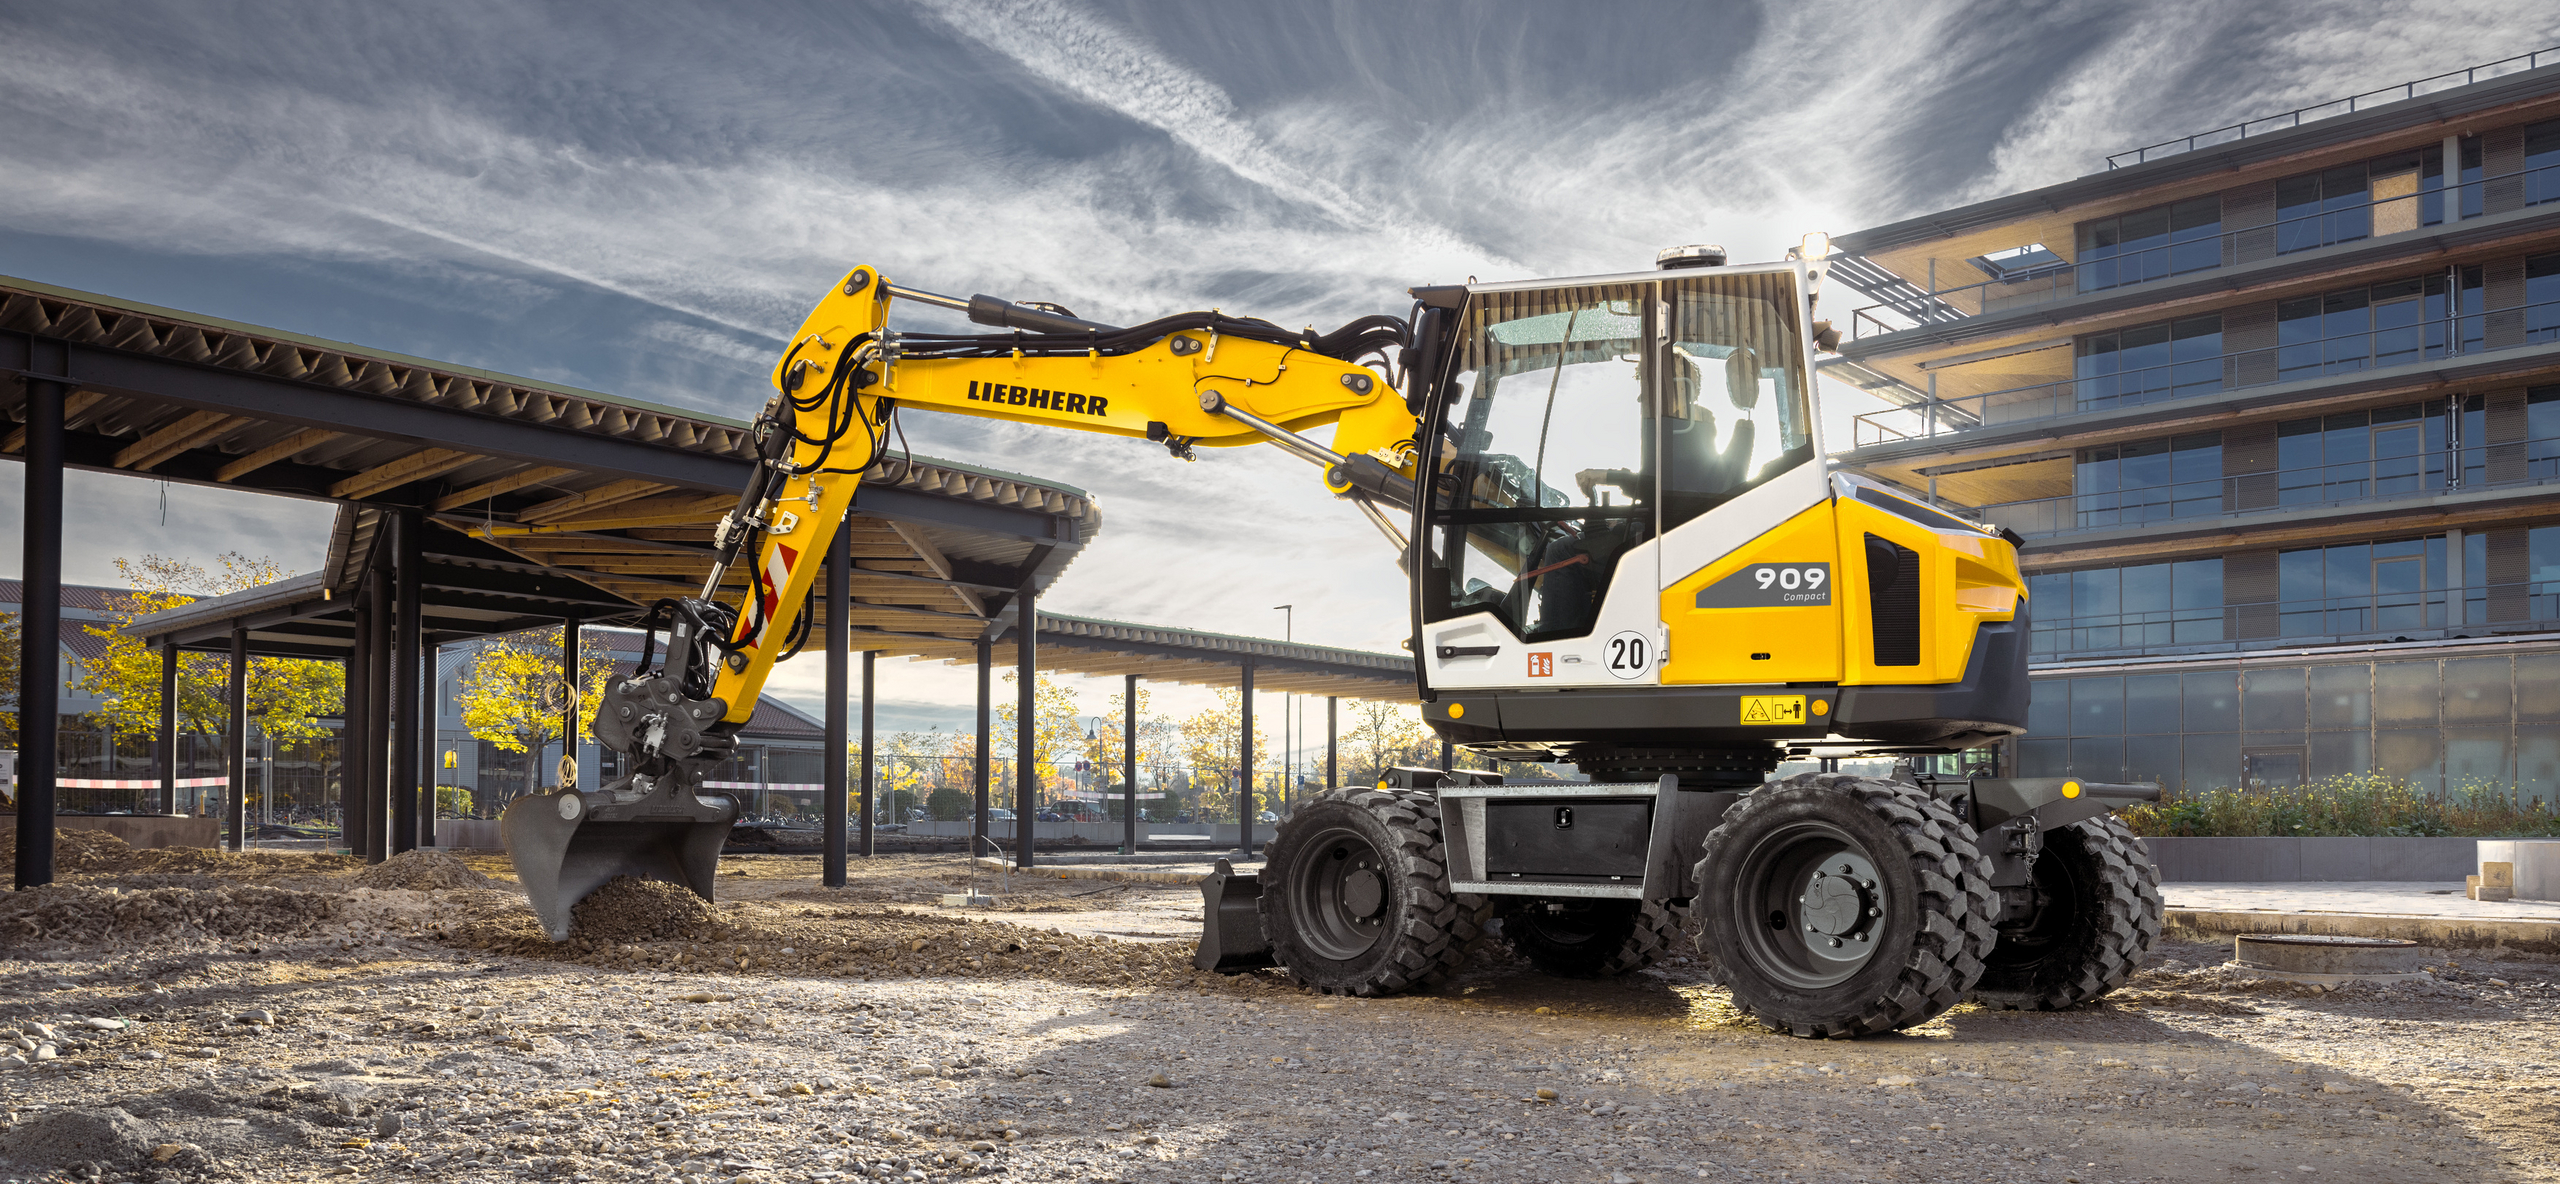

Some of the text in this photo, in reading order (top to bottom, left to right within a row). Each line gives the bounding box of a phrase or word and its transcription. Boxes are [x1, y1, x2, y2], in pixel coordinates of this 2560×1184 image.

[968, 381, 1108, 417] LIEBHERR
[1755, 568, 1825, 590] 909
[1784, 592, 1826, 602] Compact
[1612, 639, 1643, 669] 20
